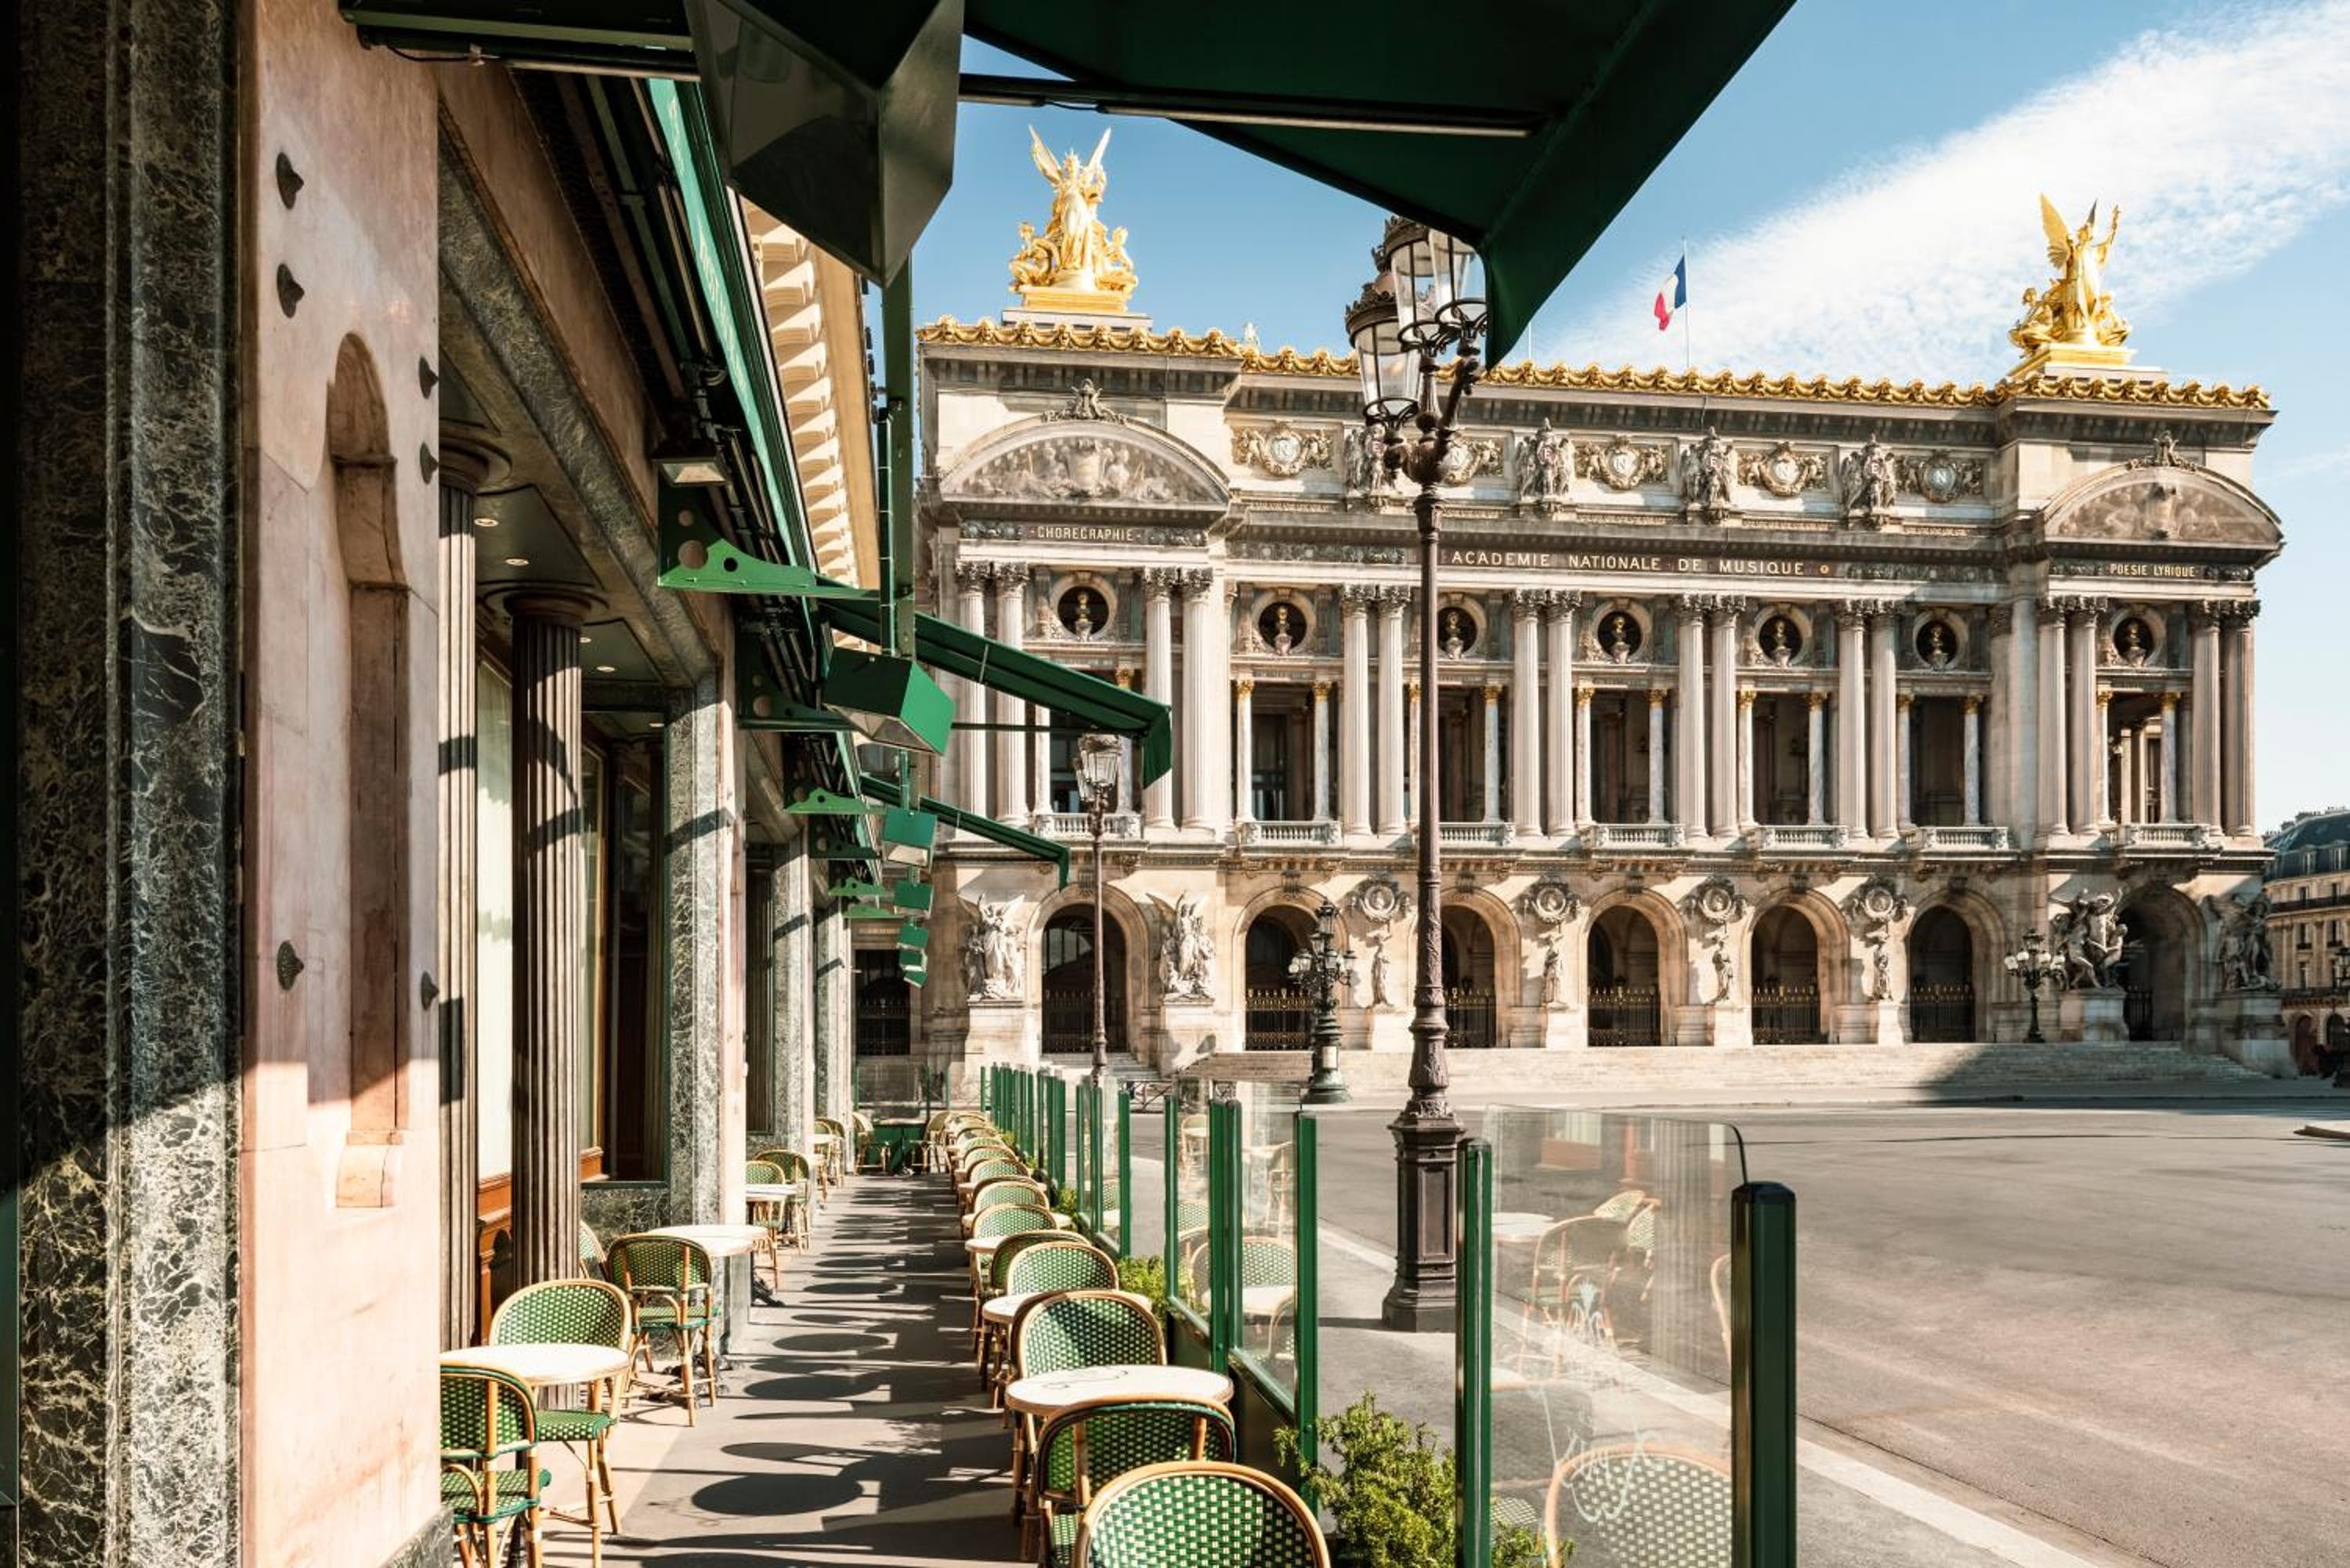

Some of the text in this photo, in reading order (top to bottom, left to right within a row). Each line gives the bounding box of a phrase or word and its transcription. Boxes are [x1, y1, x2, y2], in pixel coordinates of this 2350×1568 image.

[1038, 526, 1134, 541] CHOREGRAPHIE
[1452, 551, 1805, 576] ACADEMIE NATIONALE DE MUSIQUE
[2110, 563, 2196, 577] POESIE LYRIQUE
